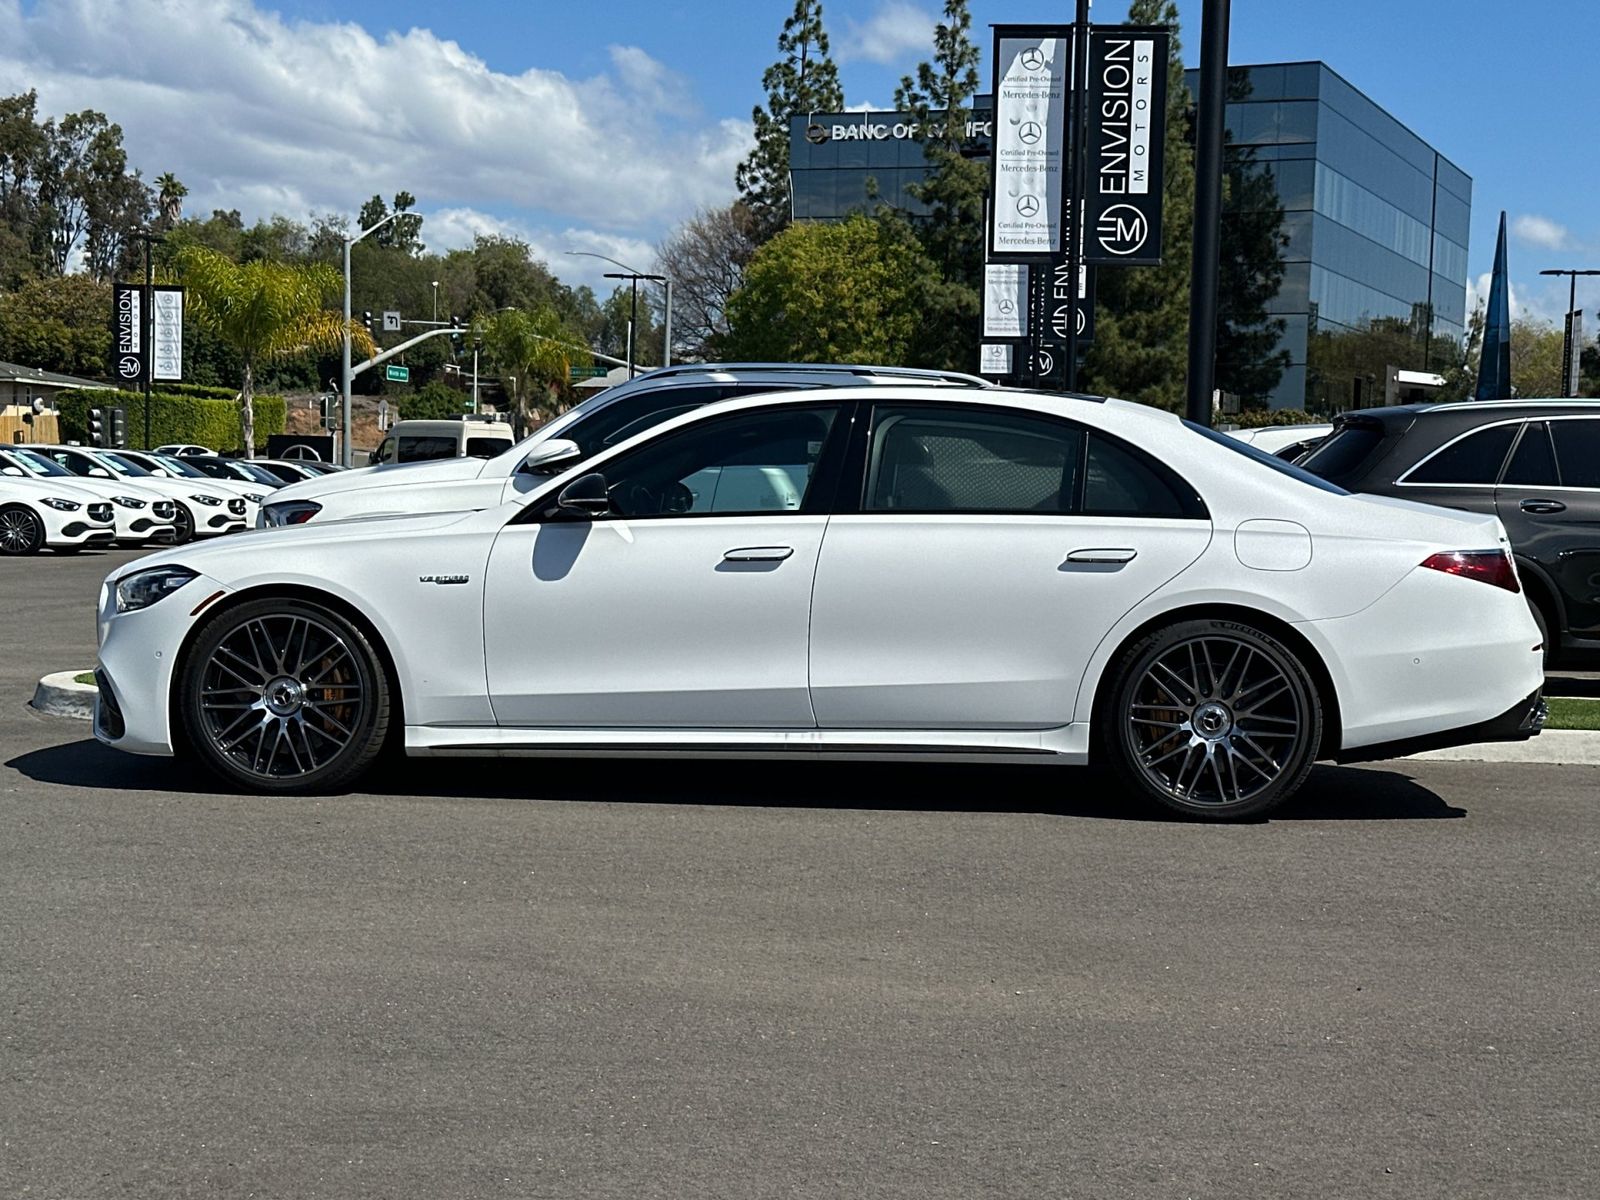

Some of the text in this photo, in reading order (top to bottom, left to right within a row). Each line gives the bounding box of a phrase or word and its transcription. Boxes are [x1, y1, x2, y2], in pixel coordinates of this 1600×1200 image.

[1002, 90, 1061, 99] Mercedes-Benz
[1100, 40, 1131, 194] ENVISION
[1134, 54, 1149, 182] MOTORS
[831, 124, 887, 140] BANC
[893, 123, 919, 139] OF
[1000, 164, 1059, 172] Mercedes-Benz
[998, 236, 1057, 245] Mercedes-Benz
[119, 289, 131, 353] ENVISION
